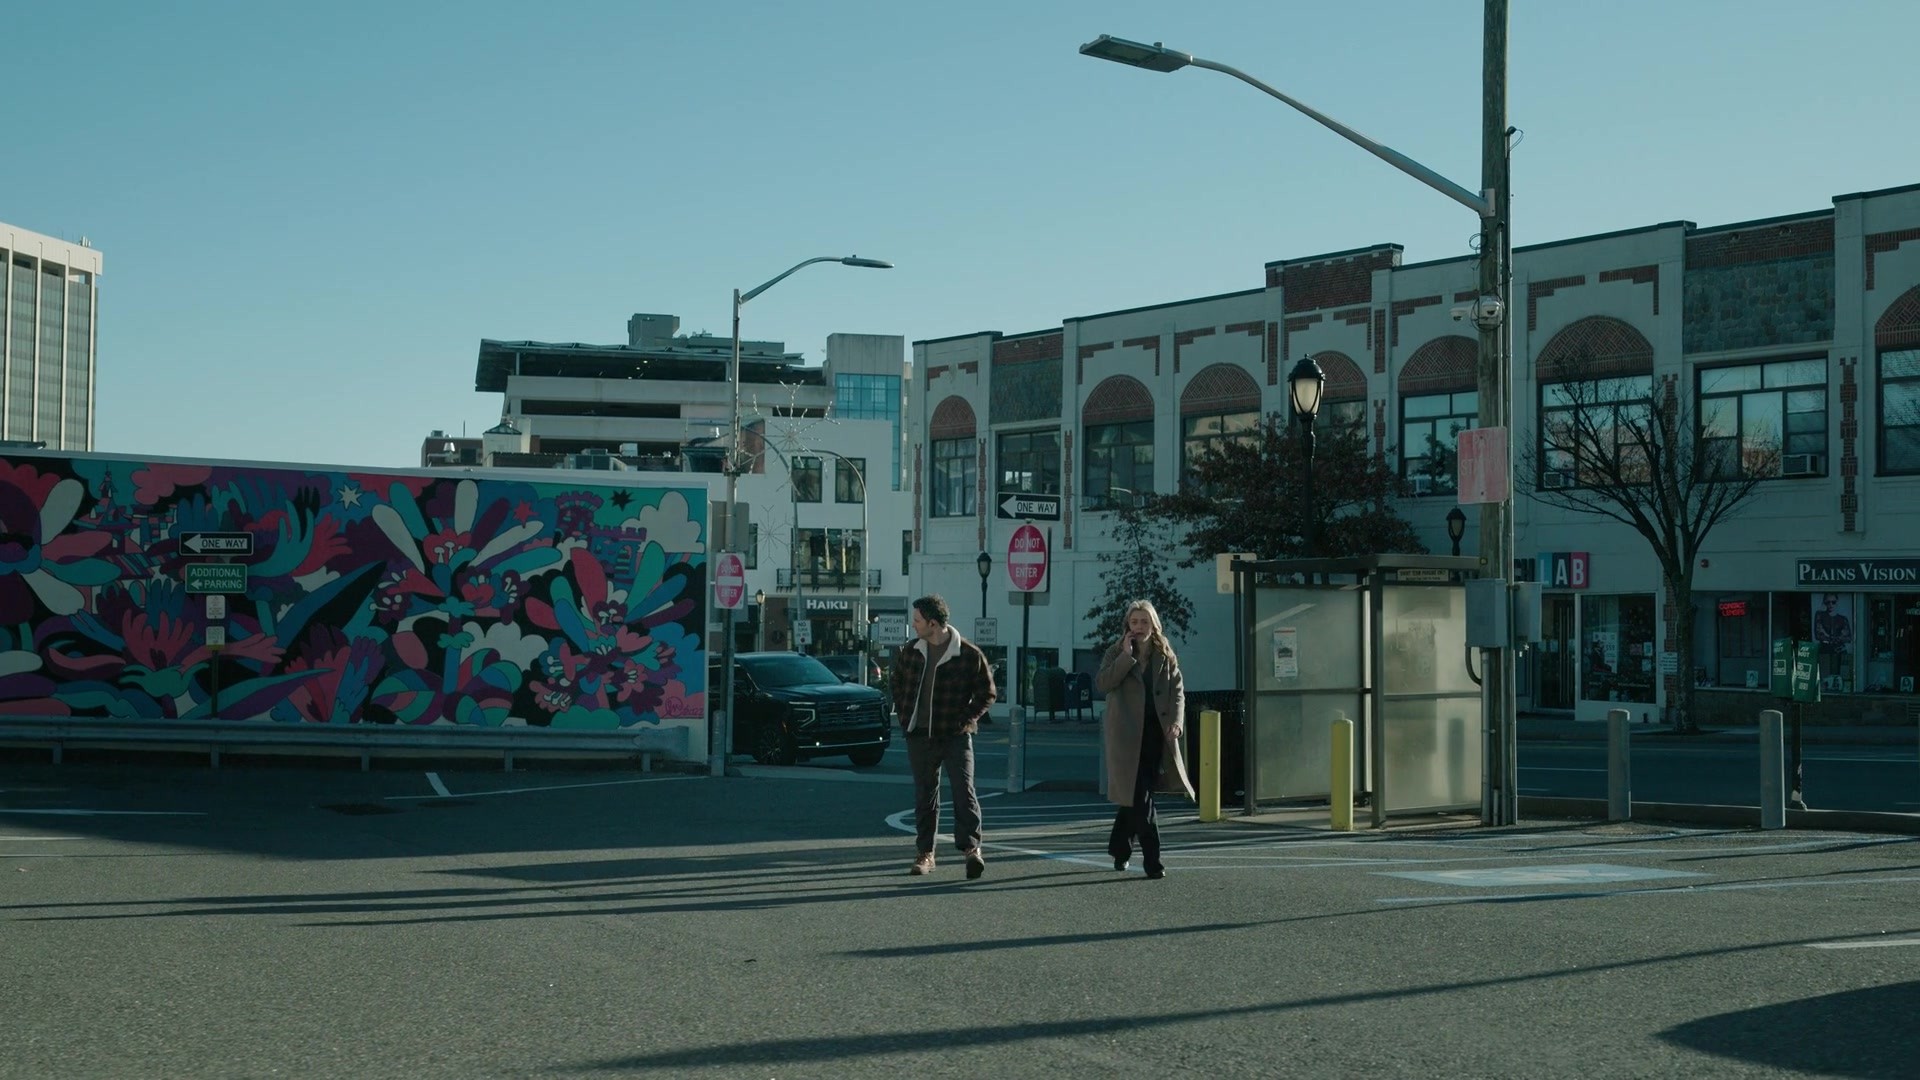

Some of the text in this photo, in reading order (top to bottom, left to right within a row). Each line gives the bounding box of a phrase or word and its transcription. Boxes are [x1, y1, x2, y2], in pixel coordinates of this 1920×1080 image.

[1016, 501, 1056, 514] ONE WAY
[202, 539, 245, 548] ONE WAY
[1015, 537, 1040, 549] DO NOT
[190, 567, 243, 578] ADDITIONAL
[729, 564, 740, 574] NOT
[1015, 567, 1038, 578] ENTER
[1540, 558, 1585, 585] LAB
[1799, 562, 1917, 581] PLAINS VISION
[204, 579, 243, 589] PARKING
[721, 588, 738, 598] ENTER
[806, 599, 848, 610] HAIKU
